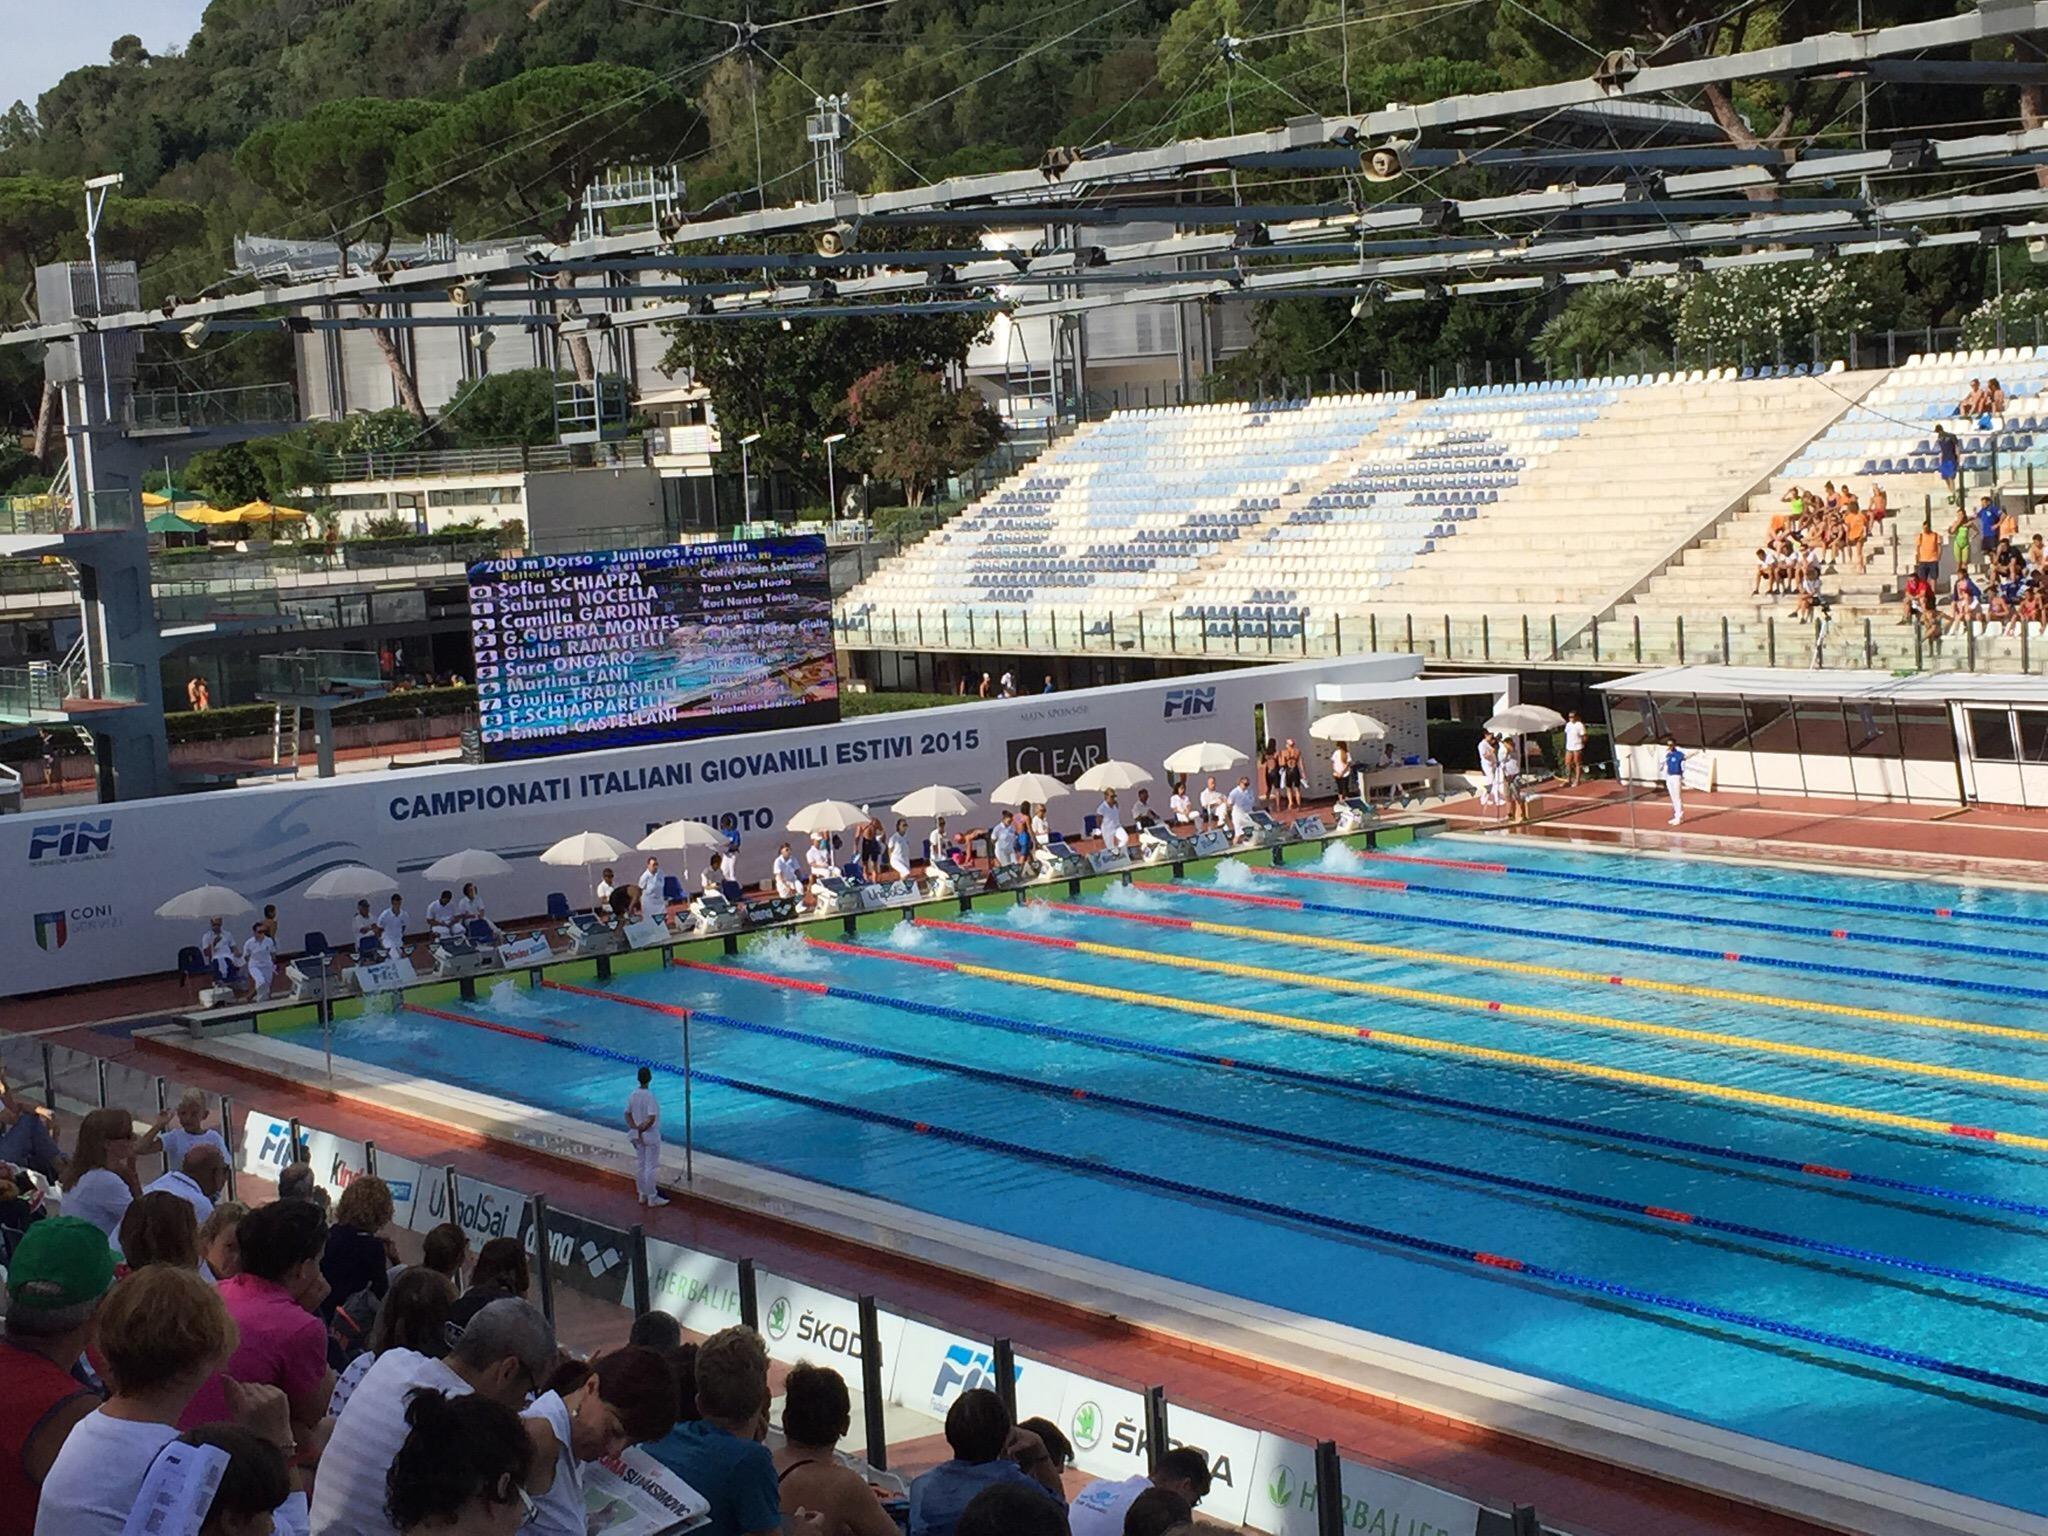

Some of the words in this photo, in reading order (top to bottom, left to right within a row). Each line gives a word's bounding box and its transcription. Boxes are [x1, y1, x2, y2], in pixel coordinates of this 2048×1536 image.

[484, 559, 517, 573] 200
[522, 561, 539, 570] m
[544, 555, 593, 568] Dorso
[498, 580, 545, 598] Sofia
[551, 572, 642, 593] SCHIAPPA
[500, 595, 572, 614] Sabrina
[577, 585, 659, 606] NOCELLA
[501, 609, 573, 629] Camilla
[579, 602, 651, 622] GARDIN
[503, 622, 599, 645] G.GUERRA
[605, 614, 680, 636] MONTES
[504, 643, 561, 661] Giulia
[567, 632, 665, 655] RAMATELLI
[505, 662, 547, 677] Sara
[553, 650, 635, 673] ONGARO
[507, 674, 581, 693] Martina
[587, 667, 629, 684] FANI
[508, 690, 565, 709] Giulia
[571, 676, 678, 702] TRABANELLI
[1164, 687, 1217, 718] FIN
[511, 724, 568, 740] Emma
[575, 708, 679, 733] CASTELLANI
[389, 777, 571, 821] CAMPIONATI
[580, 762, 693, 797] ITALIANI
[701, 745, 828, 783] GIOVANILI
[836, 735, 912, 765] ESTIVI
[920, 729, 980, 756] 2015
[28, 819, 113, 860] FIN
[71, 904, 112, 920] CONI
[654, 1268, 740, 1316] HERBALIF
[797, 1309, 864, 1360] ŠKOD
[1111, 1416, 1234, 1489] ŠKA
